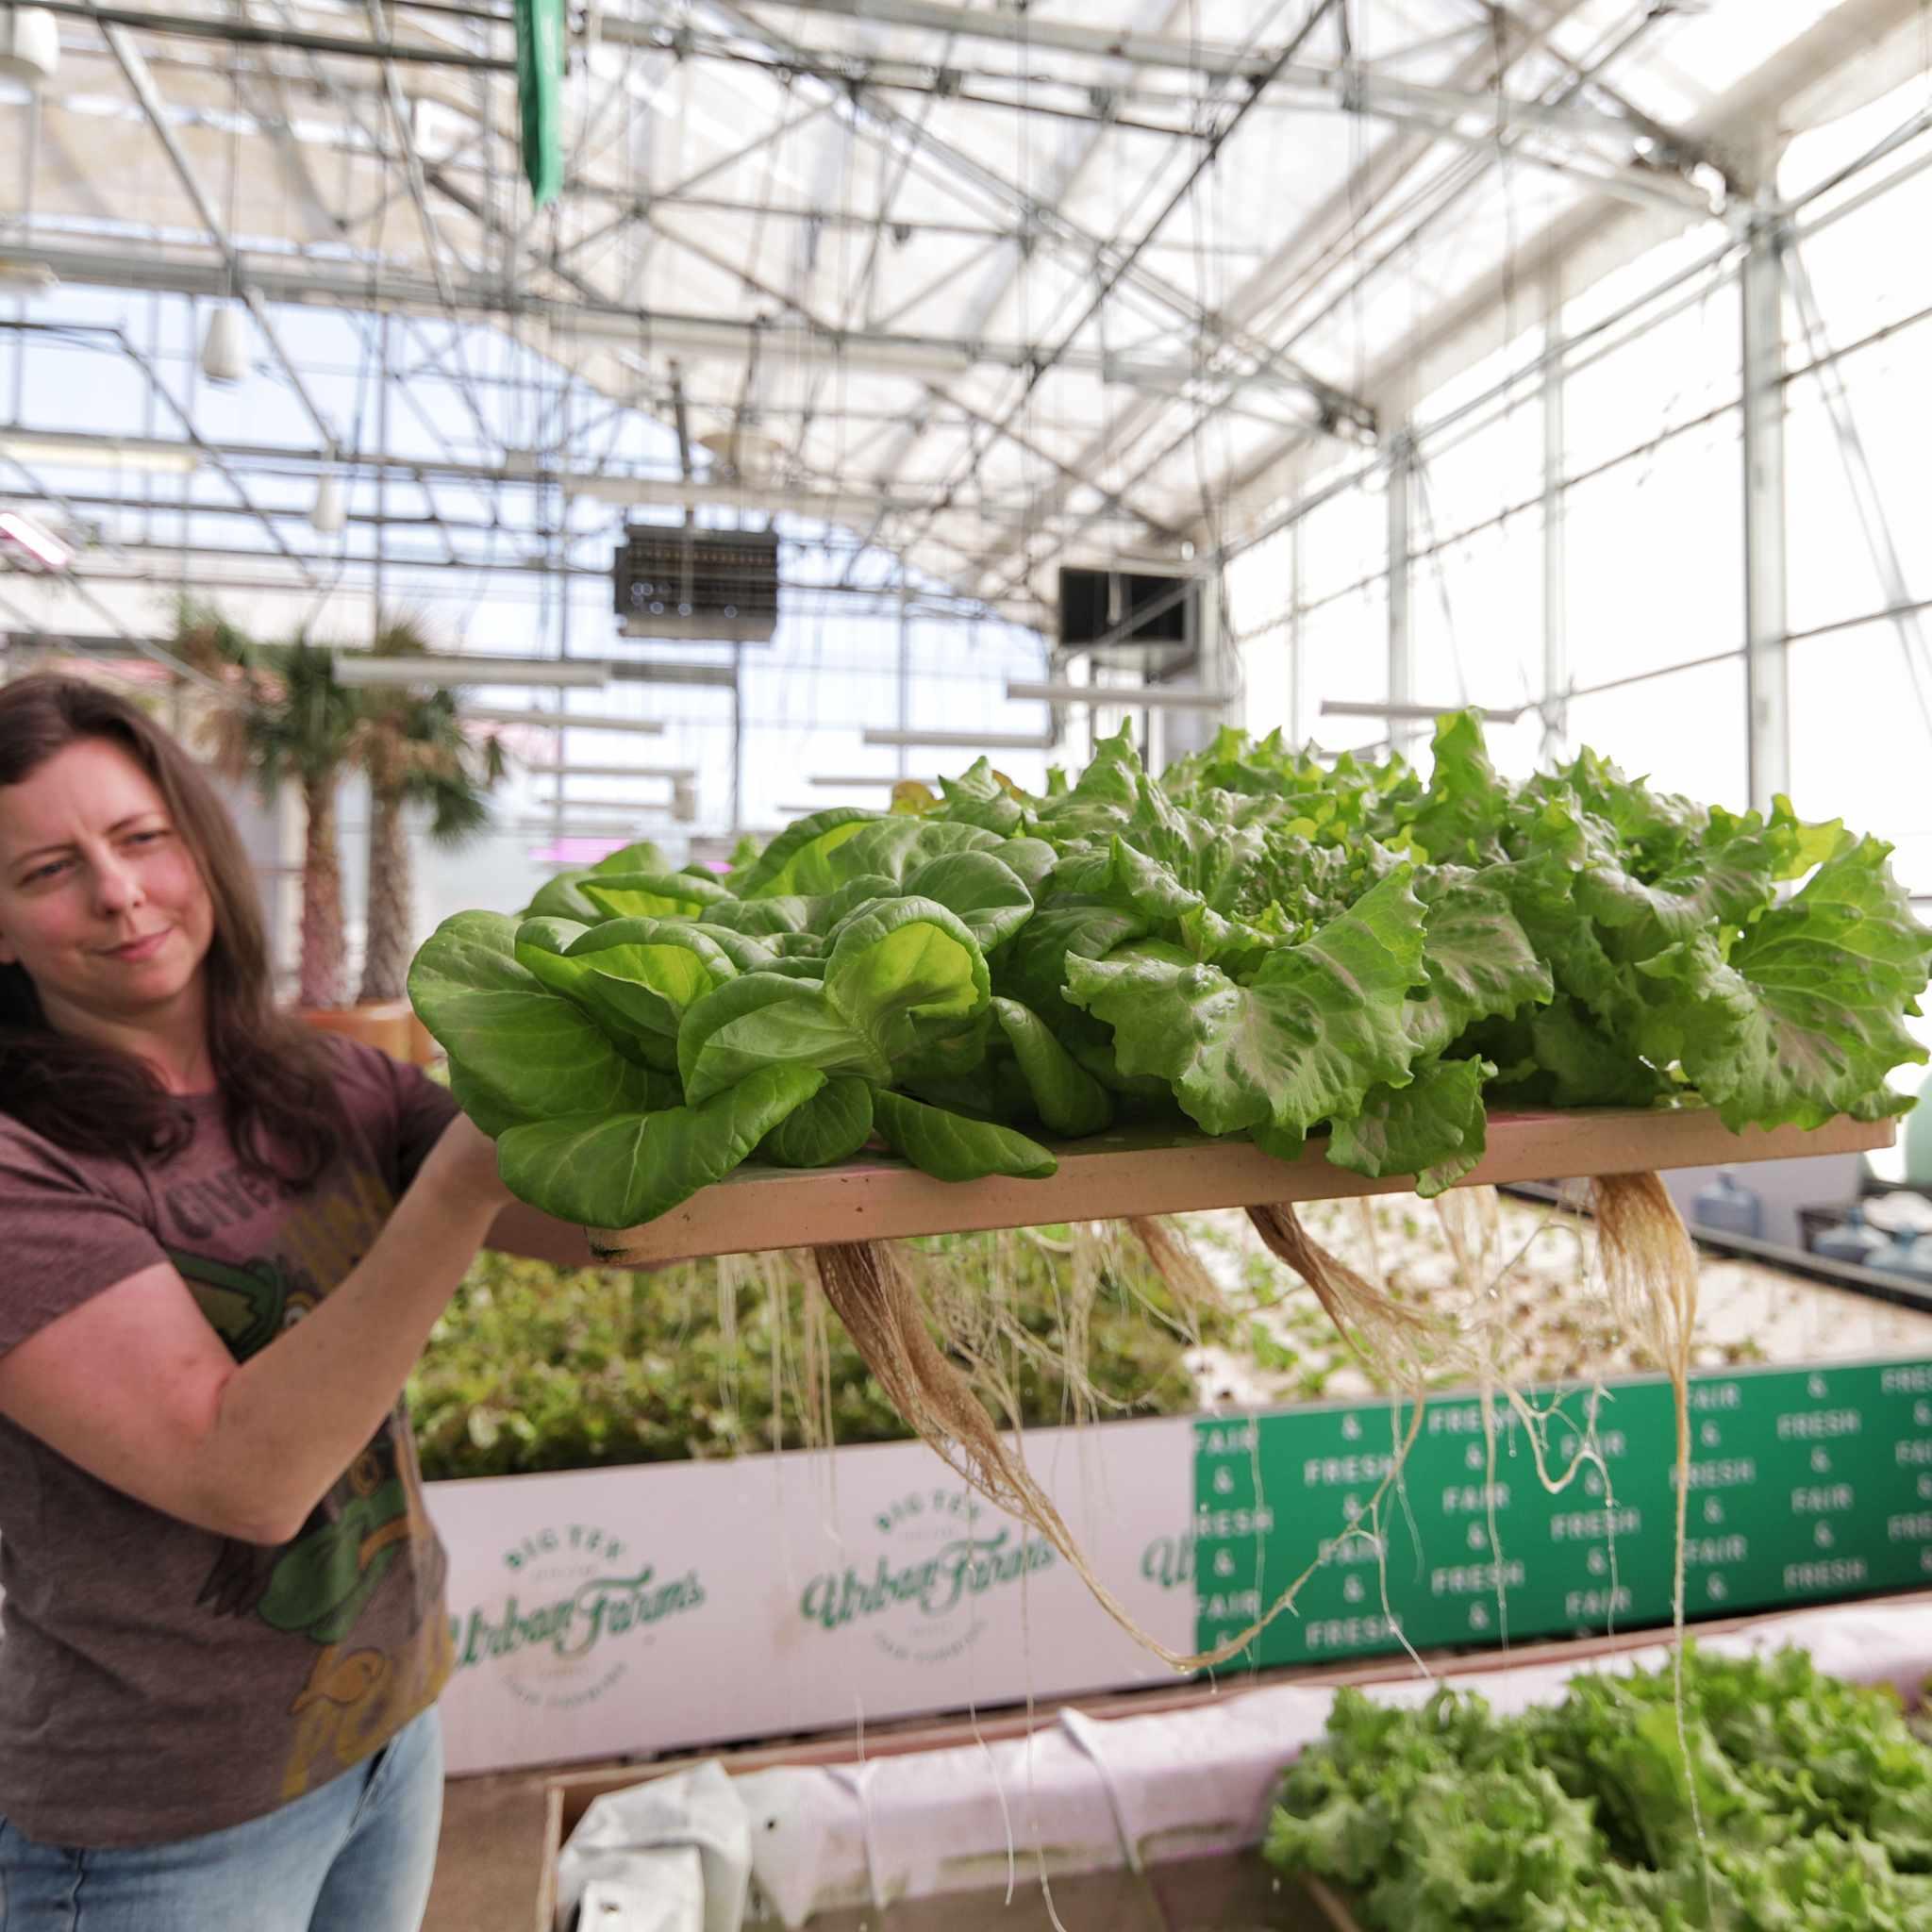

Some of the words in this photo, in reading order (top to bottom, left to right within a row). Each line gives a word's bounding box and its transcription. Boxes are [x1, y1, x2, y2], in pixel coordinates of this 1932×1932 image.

[1687, 1384, 1740, 1411] AIR
[1777, 1410, 1860, 1440] FRESH
[1792, 1484, 1853, 1511] FAIR
[1193, 1508, 1273, 1538] RESH
[1551, 1507, 1640, 1541] FRESH
[1432, 1559, 1524, 1596] FRESH
[1785, 1558, 1866, 1590] FRESH
[800, 1556, 941, 1629] Urban
[1566, 1588, 1631, 1619] FAIR
[557, 1566, 705, 1659] Farms
